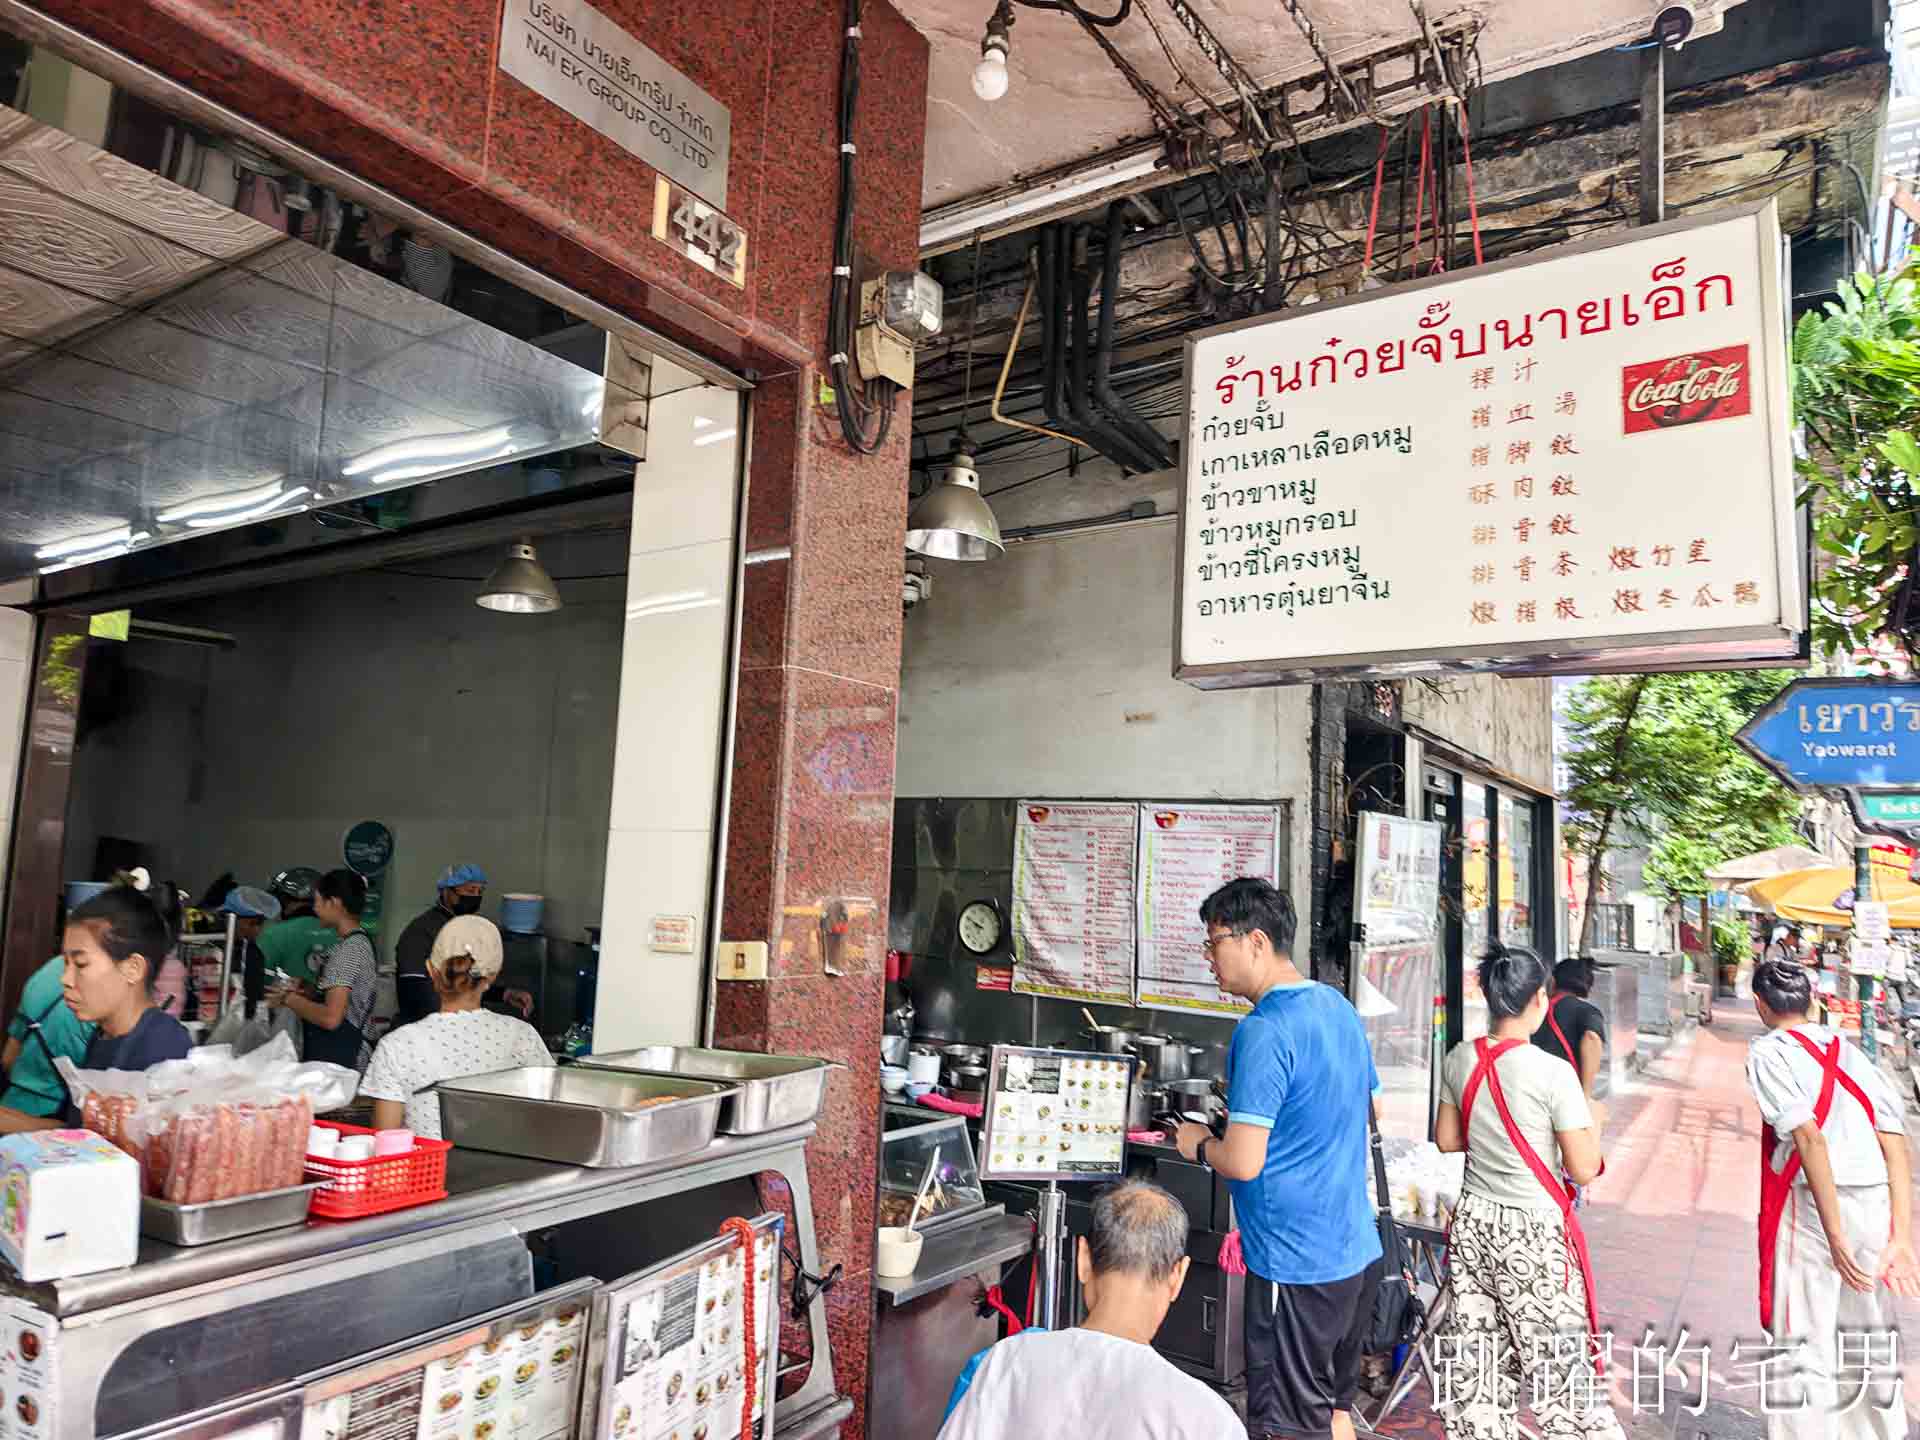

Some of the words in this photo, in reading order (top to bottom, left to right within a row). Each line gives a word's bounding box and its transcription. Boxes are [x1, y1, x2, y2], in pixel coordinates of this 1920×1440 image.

[526, 33, 556, 68] NAI
[560, 58, 584, 87] EK
[587, 78, 646, 125] GROUP
[672, 193, 740, 270] 442
[1215, 256, 1735, 405] ร้านก๋วยจั๊บนายเอ็ก
[1202, 400, 1285, 442] ก๋วยจั๊บ
[1201, 425, 1412, 477] เกาเหลาเลือดหมู
[1201, 478, 1316, 511] ข้าวขาหมู
[1199, 508, 1358, 546] ข้าวหมูกรอบ
[1198, 543, 1361, 582] ข้าวซี่โครงหมู
[1198, 572, 1391, 618] อาหารตุ๋นยาจีน
[1801, 742, 1897, 758] Yaowarat
